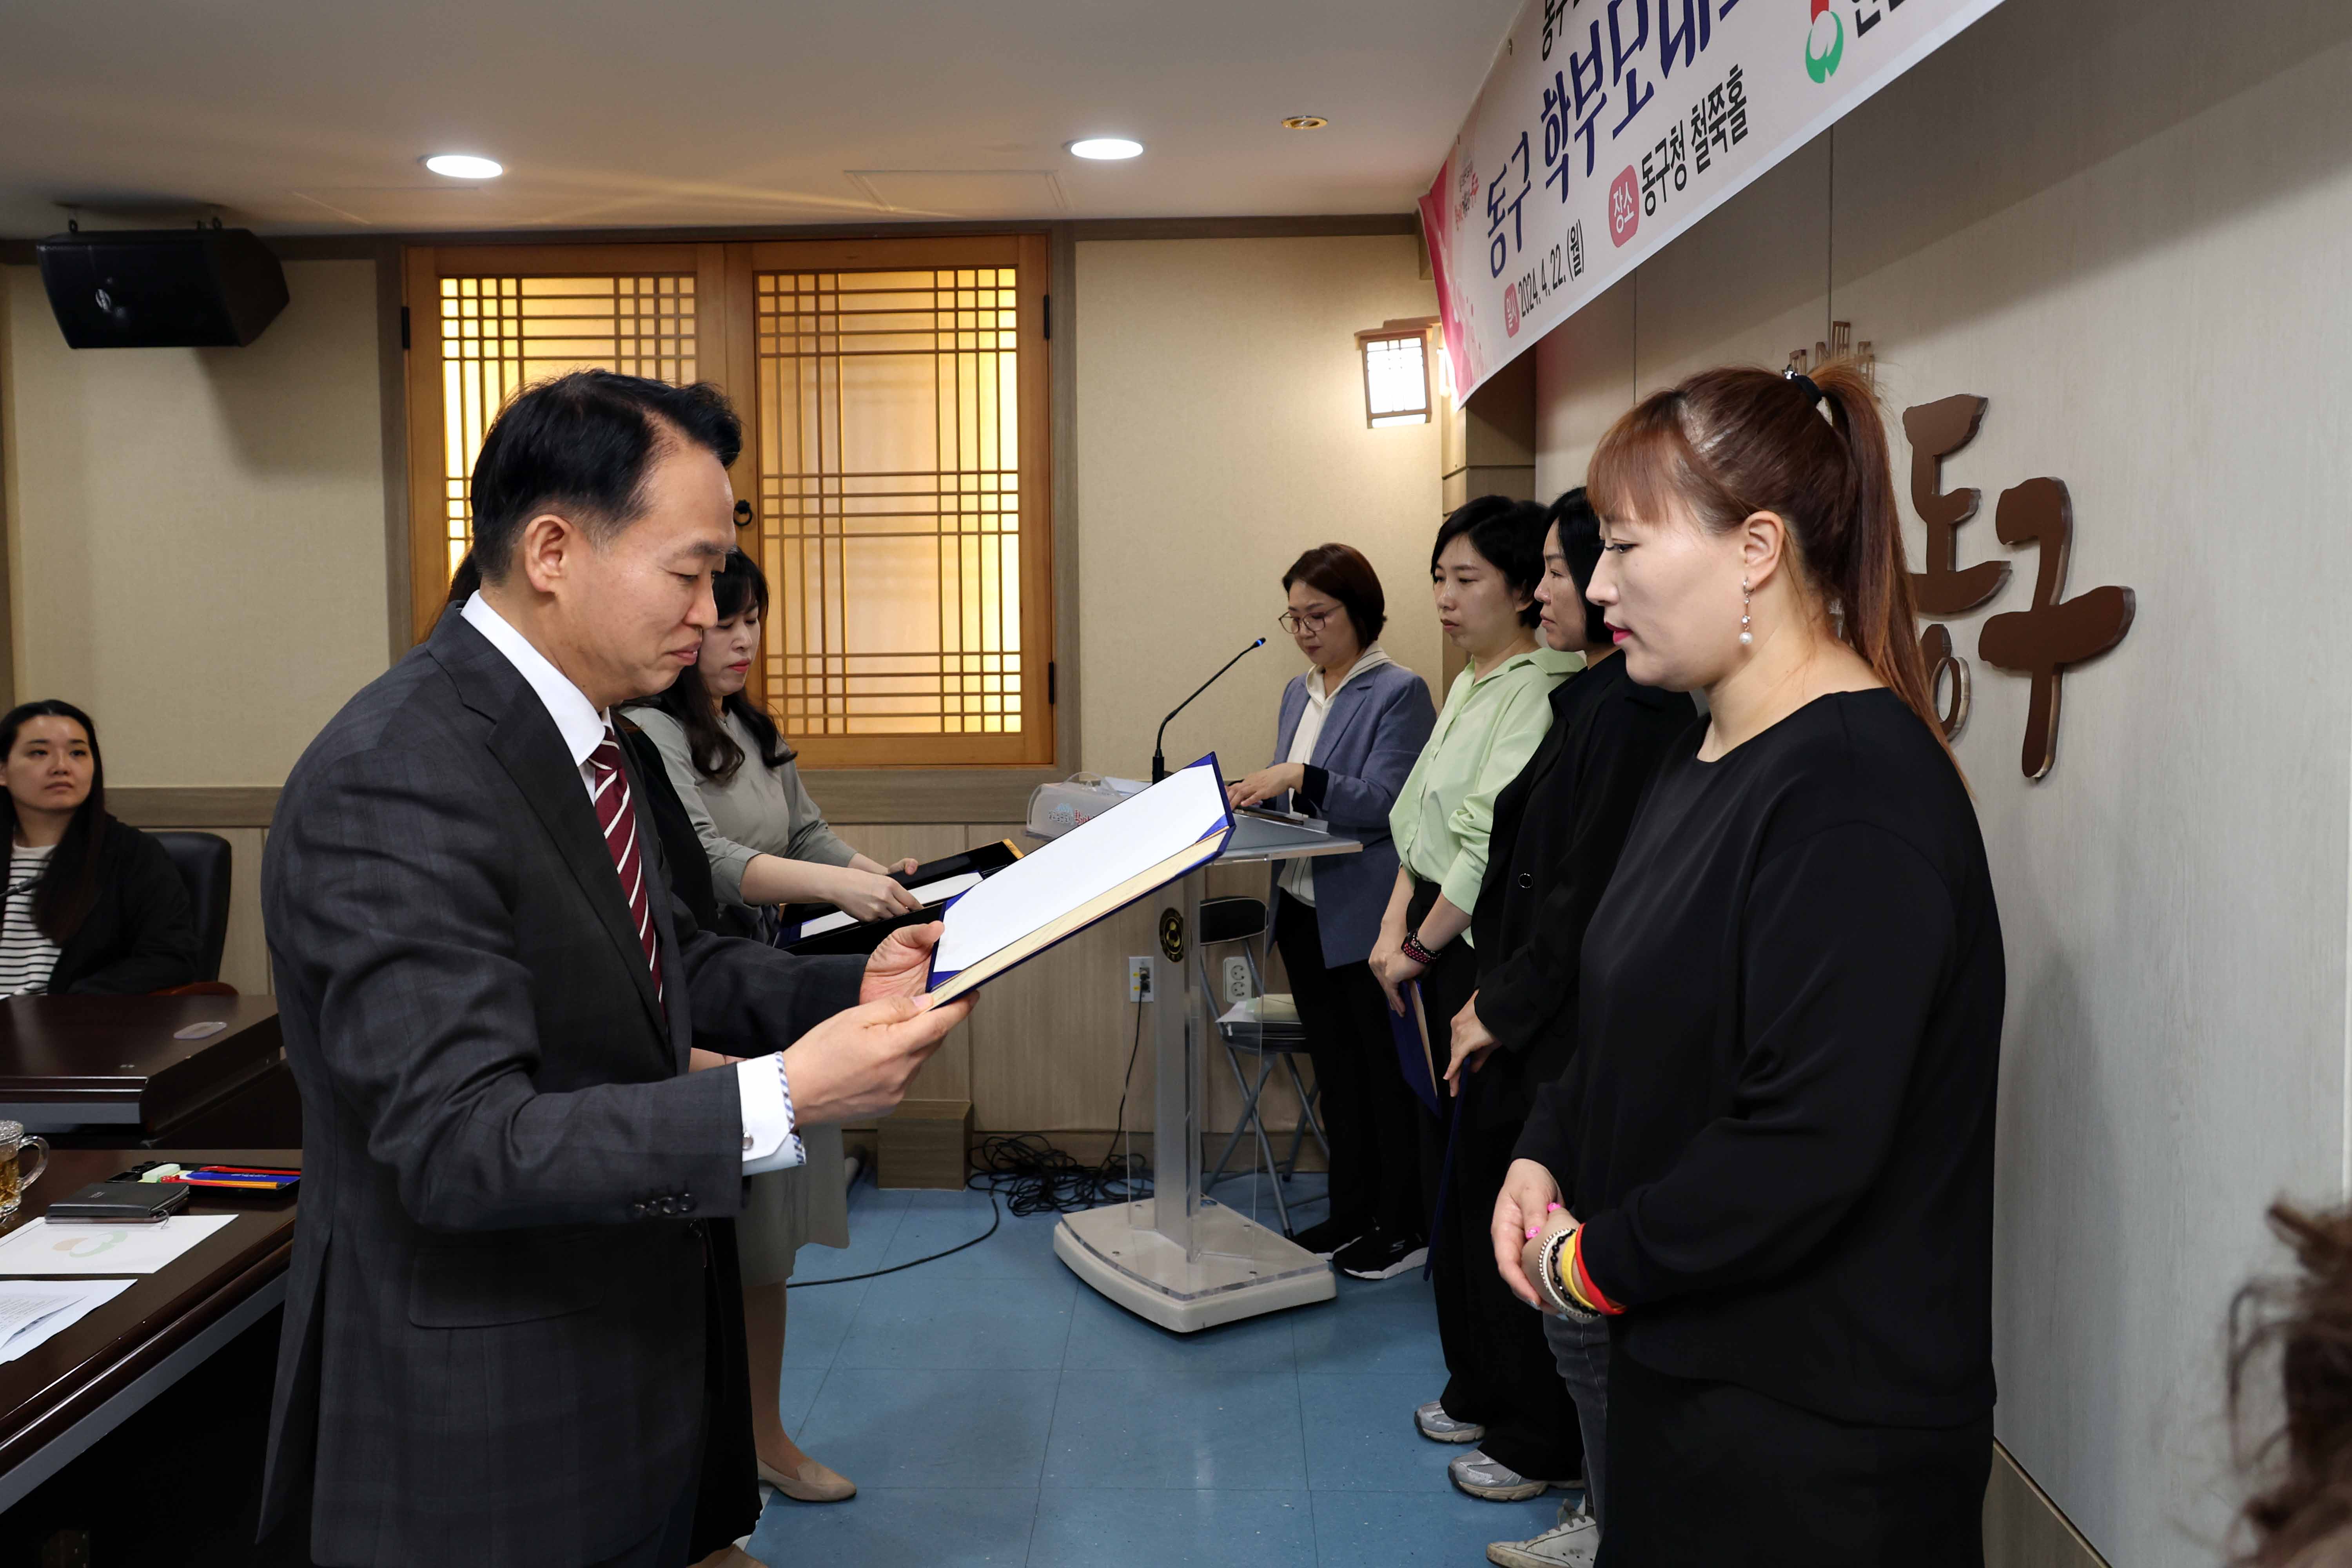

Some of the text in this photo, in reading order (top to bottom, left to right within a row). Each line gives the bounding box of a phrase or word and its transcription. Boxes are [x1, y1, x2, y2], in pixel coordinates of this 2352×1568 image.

[1488, 131, 1531, 279] 동구
[1541, 0, 1740, 204] 학부모대
[1613, 64, 1748, 234] 장소 동구청 철쭉홀
[1506, 219, 1584, 329] 일시 2024. 4. 22. (월)
[1902, 393, 2136, 779] 동구
